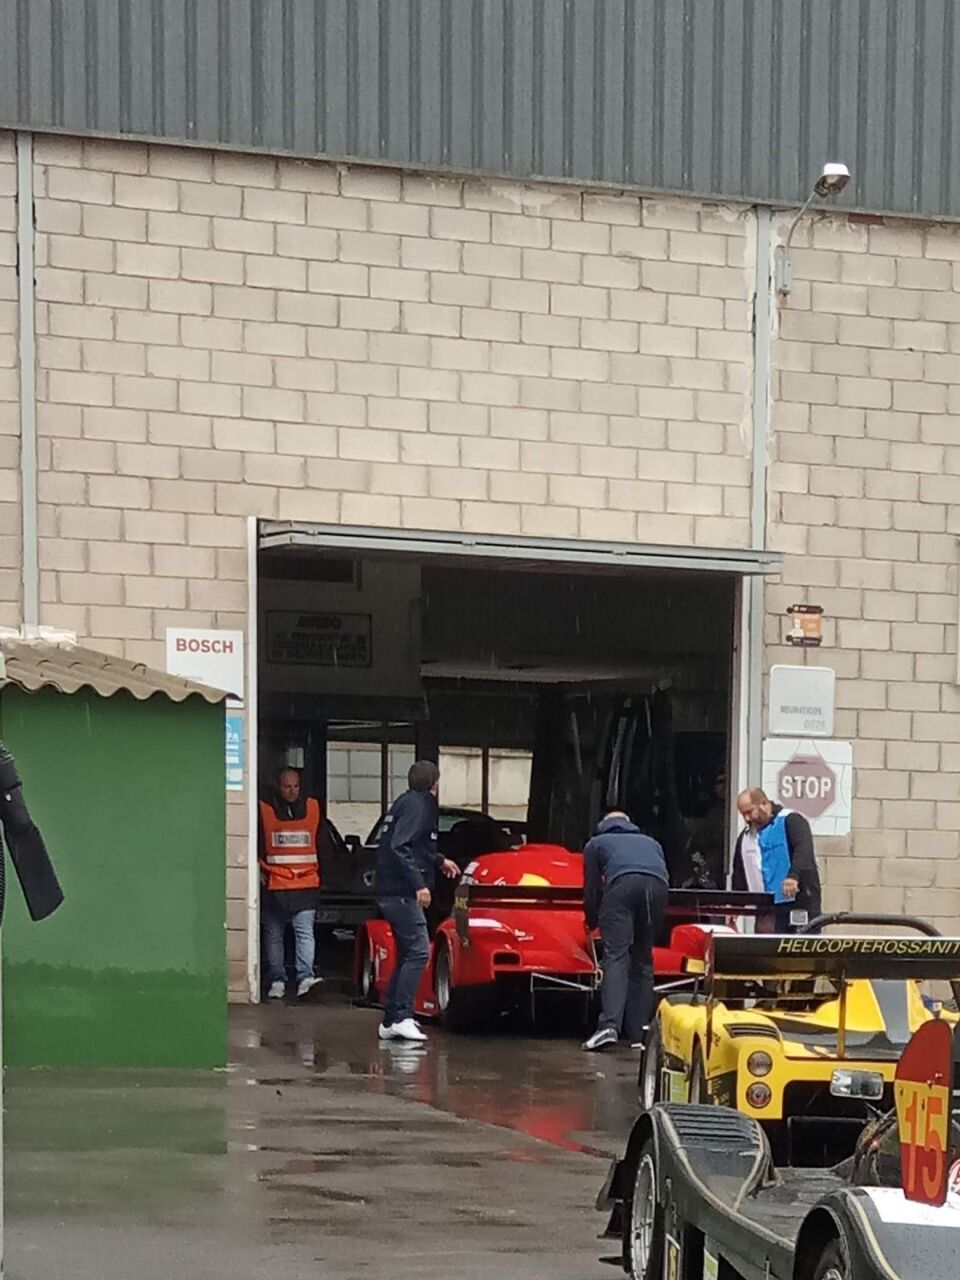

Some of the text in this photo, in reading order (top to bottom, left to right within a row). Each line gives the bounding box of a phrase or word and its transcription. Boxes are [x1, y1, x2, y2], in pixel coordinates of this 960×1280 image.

[176, 638, 234, 654] BOSCH
[781, 775, 833, 799] STOP
[905, 1090, 944, 1199] 15
